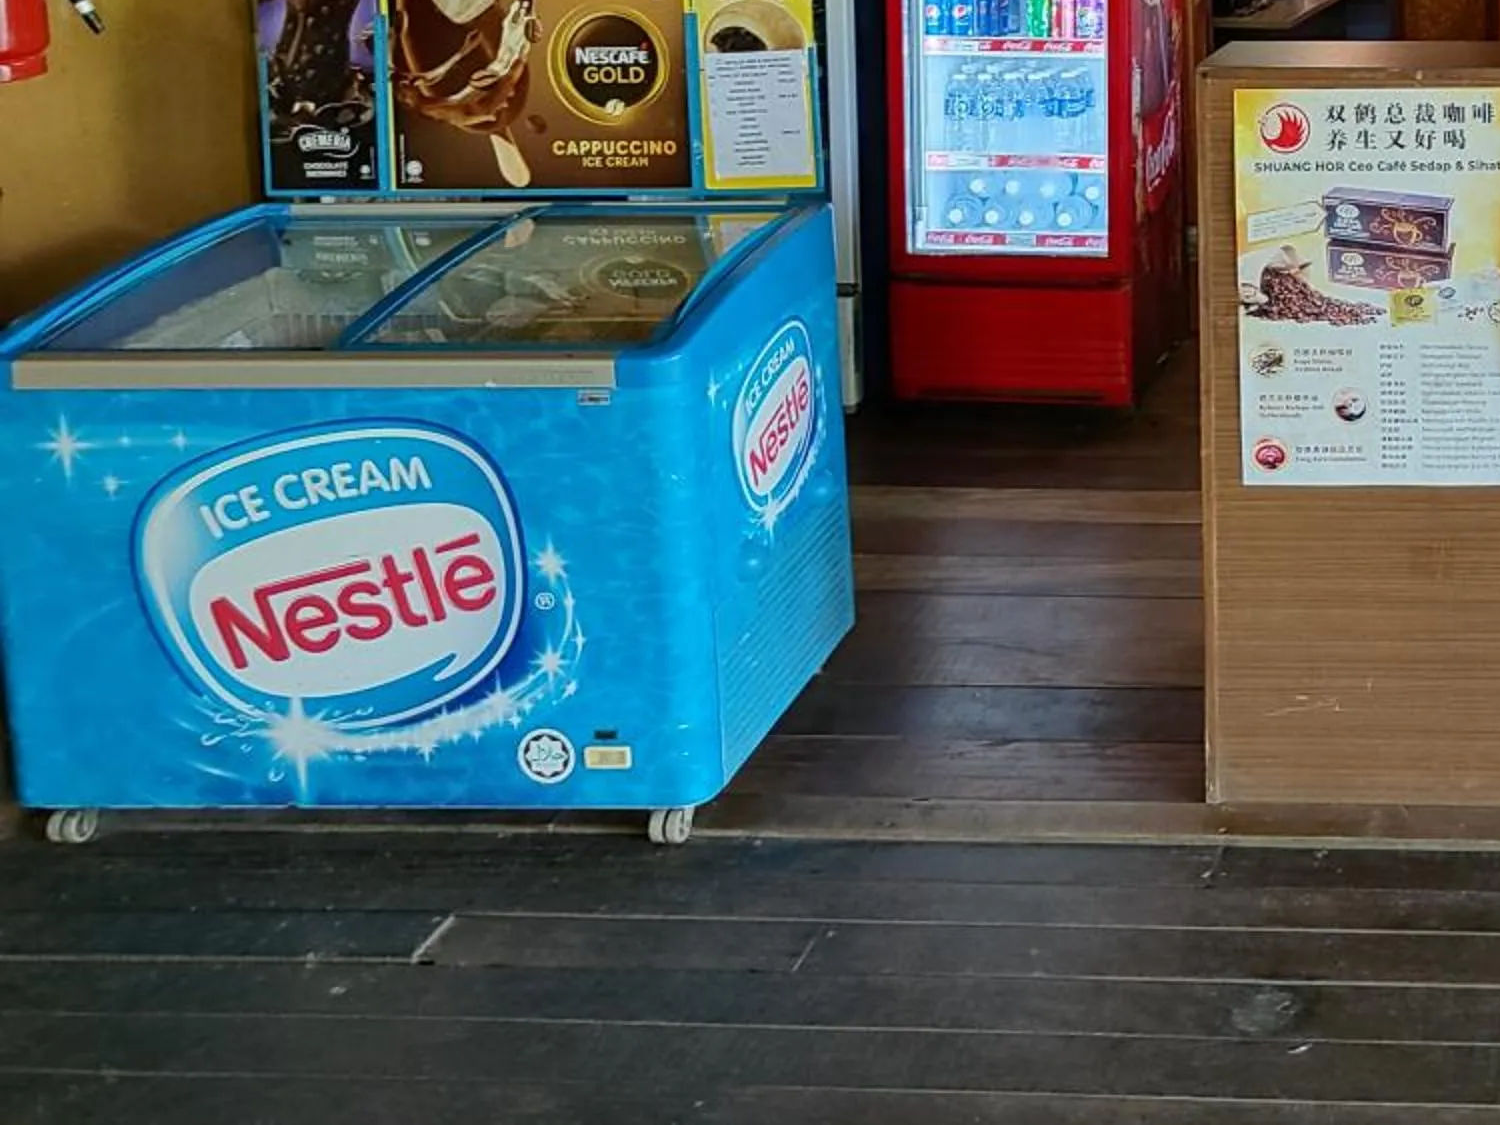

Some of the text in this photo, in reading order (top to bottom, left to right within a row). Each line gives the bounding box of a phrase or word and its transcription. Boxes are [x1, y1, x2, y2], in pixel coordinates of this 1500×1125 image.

[584, 67, 645, 84] GOLD
[552, 140, 678, 155] CAPPUCCINO
[582, 156, 649, 168] ICE CREAM
[1254, 161, 1311, 173] SHUANG
[1315, 161, 1345, 172] HOR
[1348, 161, 1373, 172] Ceo
[1377, 159, 1406, 172] Café
[1410, 160, 1451, 174] Sedap
[1455, 160, 1464, 171] &
[744, 335, 796, 416] ICE CREAM
[199, 454, 434, 543] ICE CREAM
